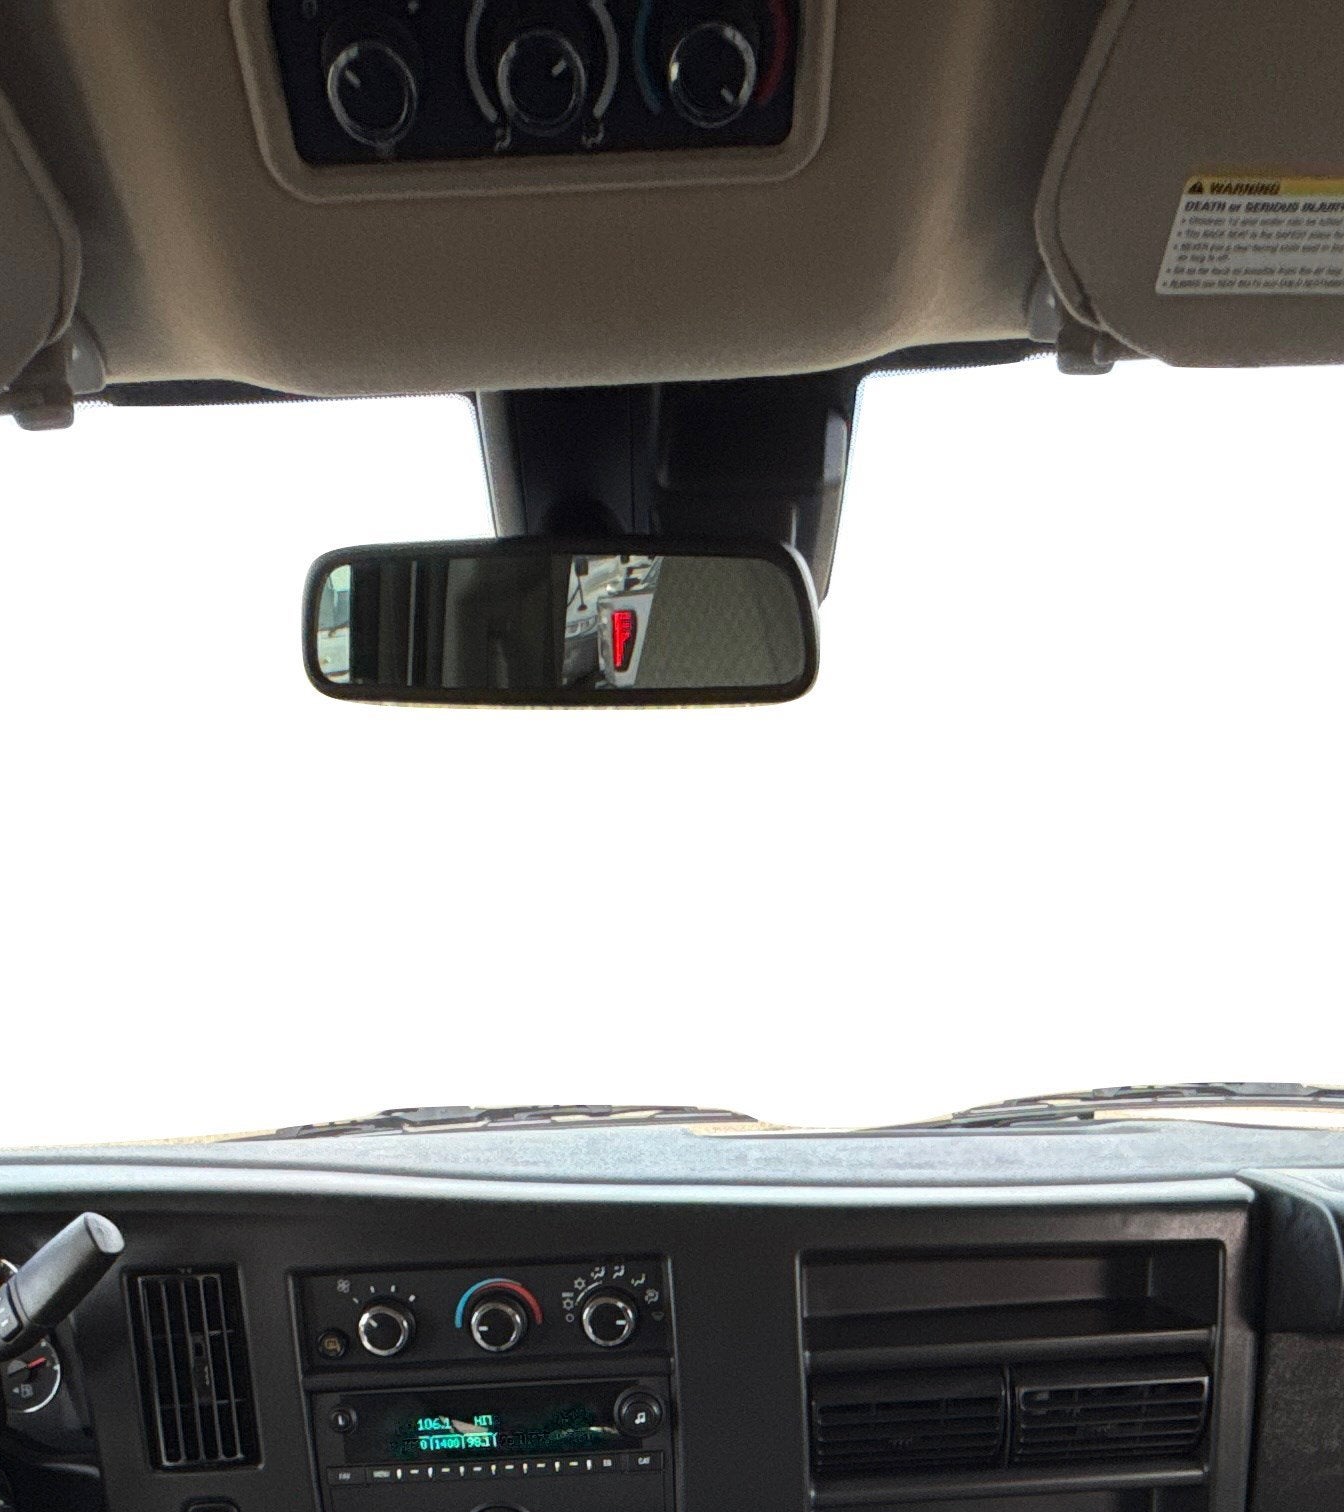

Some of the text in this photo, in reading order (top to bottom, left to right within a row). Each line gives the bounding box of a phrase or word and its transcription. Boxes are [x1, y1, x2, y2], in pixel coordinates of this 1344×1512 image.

[1209, 182, 1281, 195] WARNING
[1184, 201, 1227, 212] DEATH
[417, 1417, 452, 1431] 106.1
